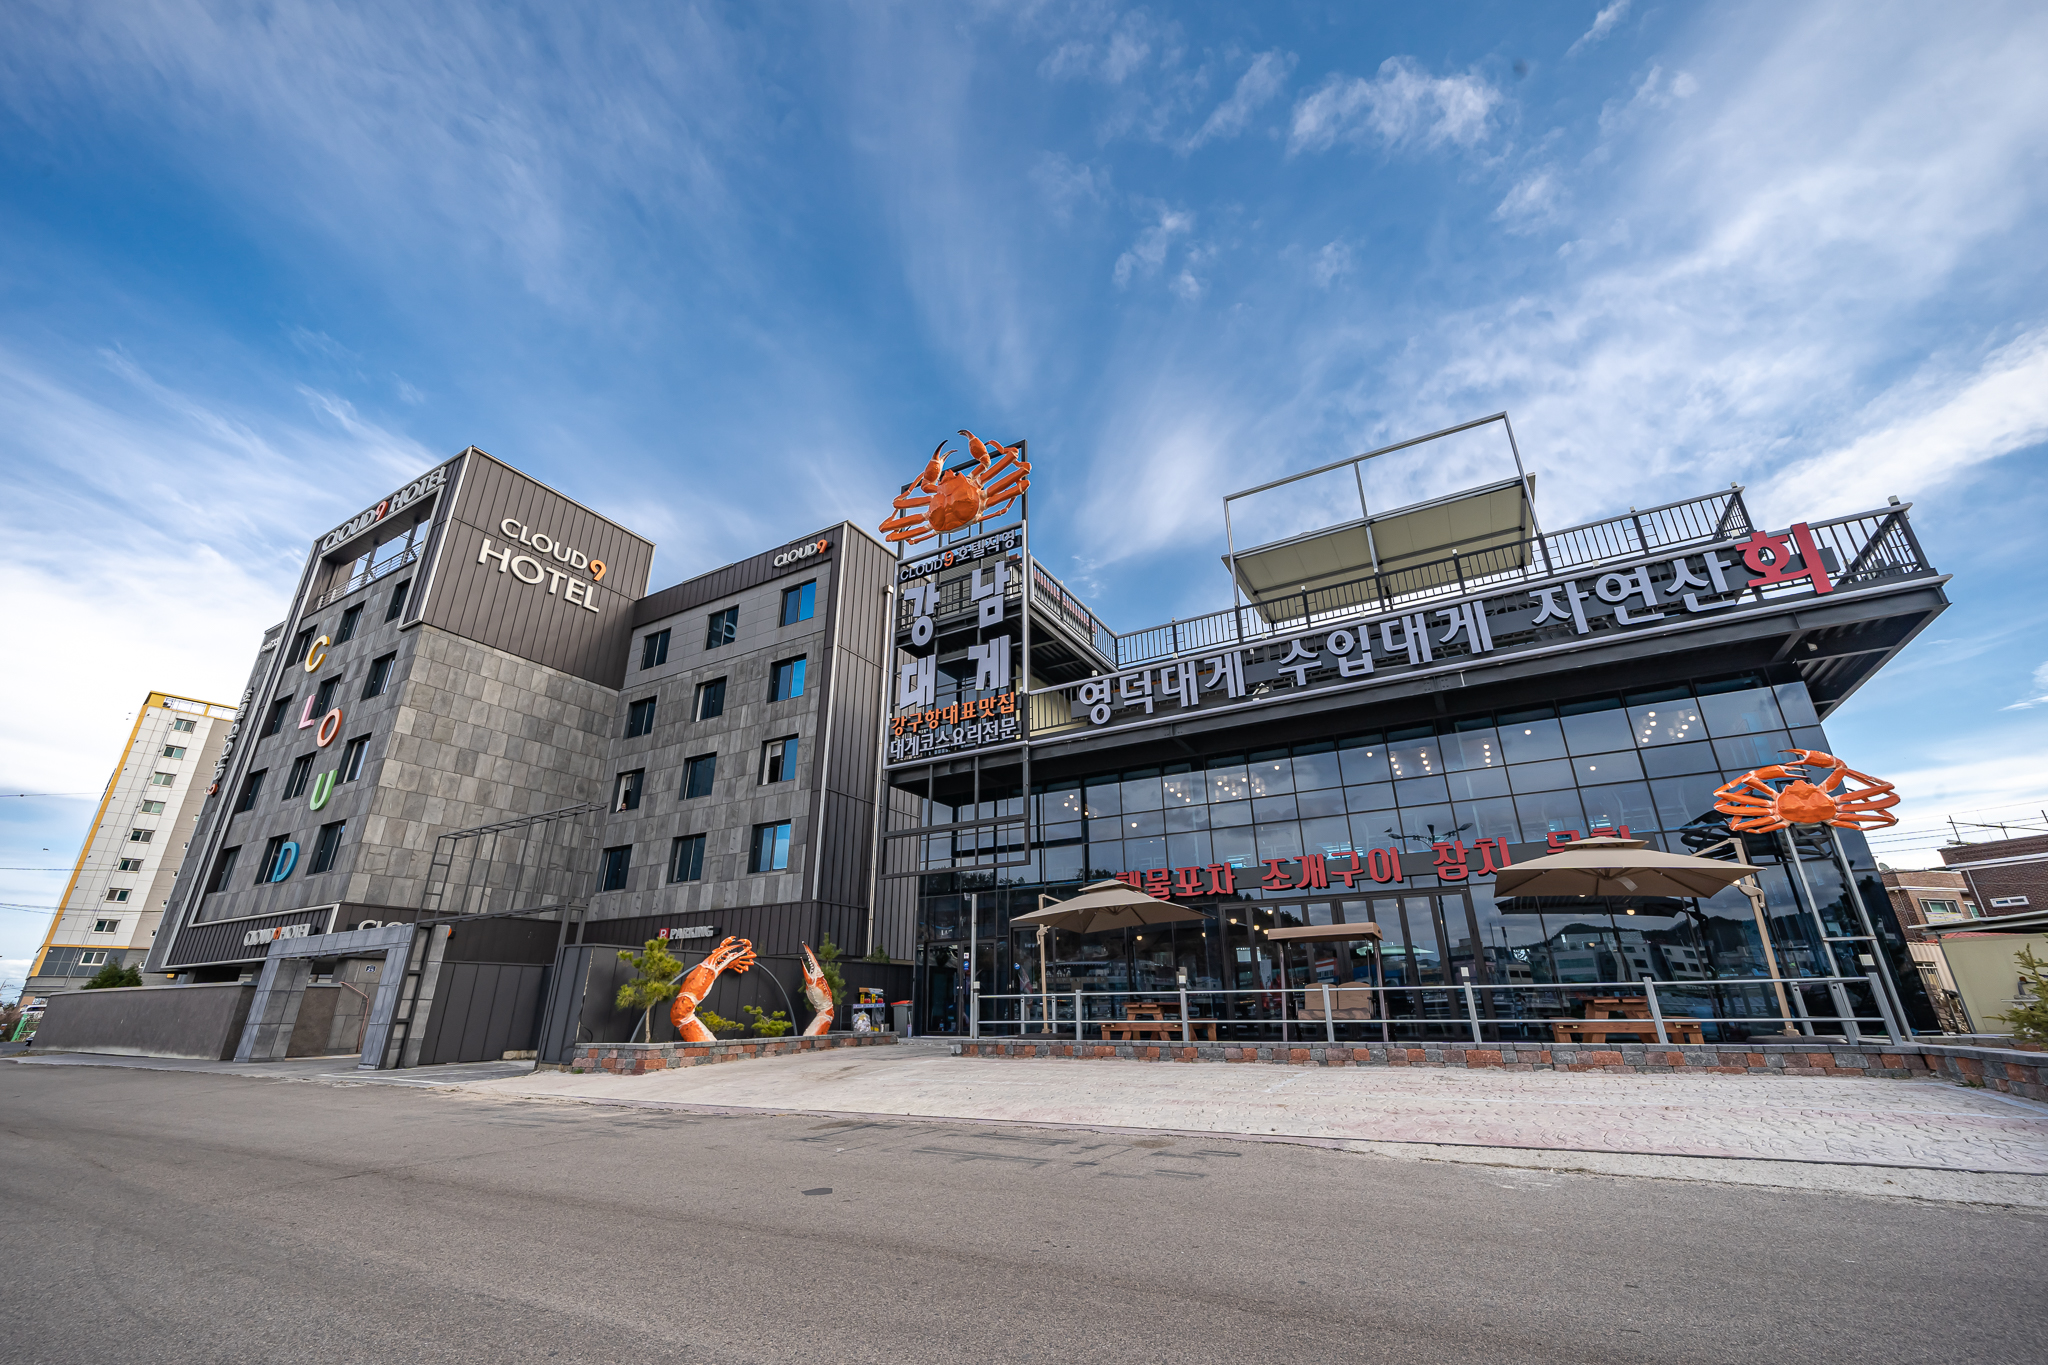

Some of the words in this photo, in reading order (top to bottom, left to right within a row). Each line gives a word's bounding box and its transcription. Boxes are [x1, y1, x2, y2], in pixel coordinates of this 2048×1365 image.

[389, 466, 446, 512] HOTEL
[956, 529, 1015, 562] 호텔직영
[477, 539, 599, 613] HOTEL
[1079, 651, 1246, 725] 영덕대게
[1278, 600, 1493, 686] 수입대게
[1261, 847, 1403, 890] 조개구이
[1431, 836, 1512, 881] 참치
[669, 925, 713, 940] PARKING
